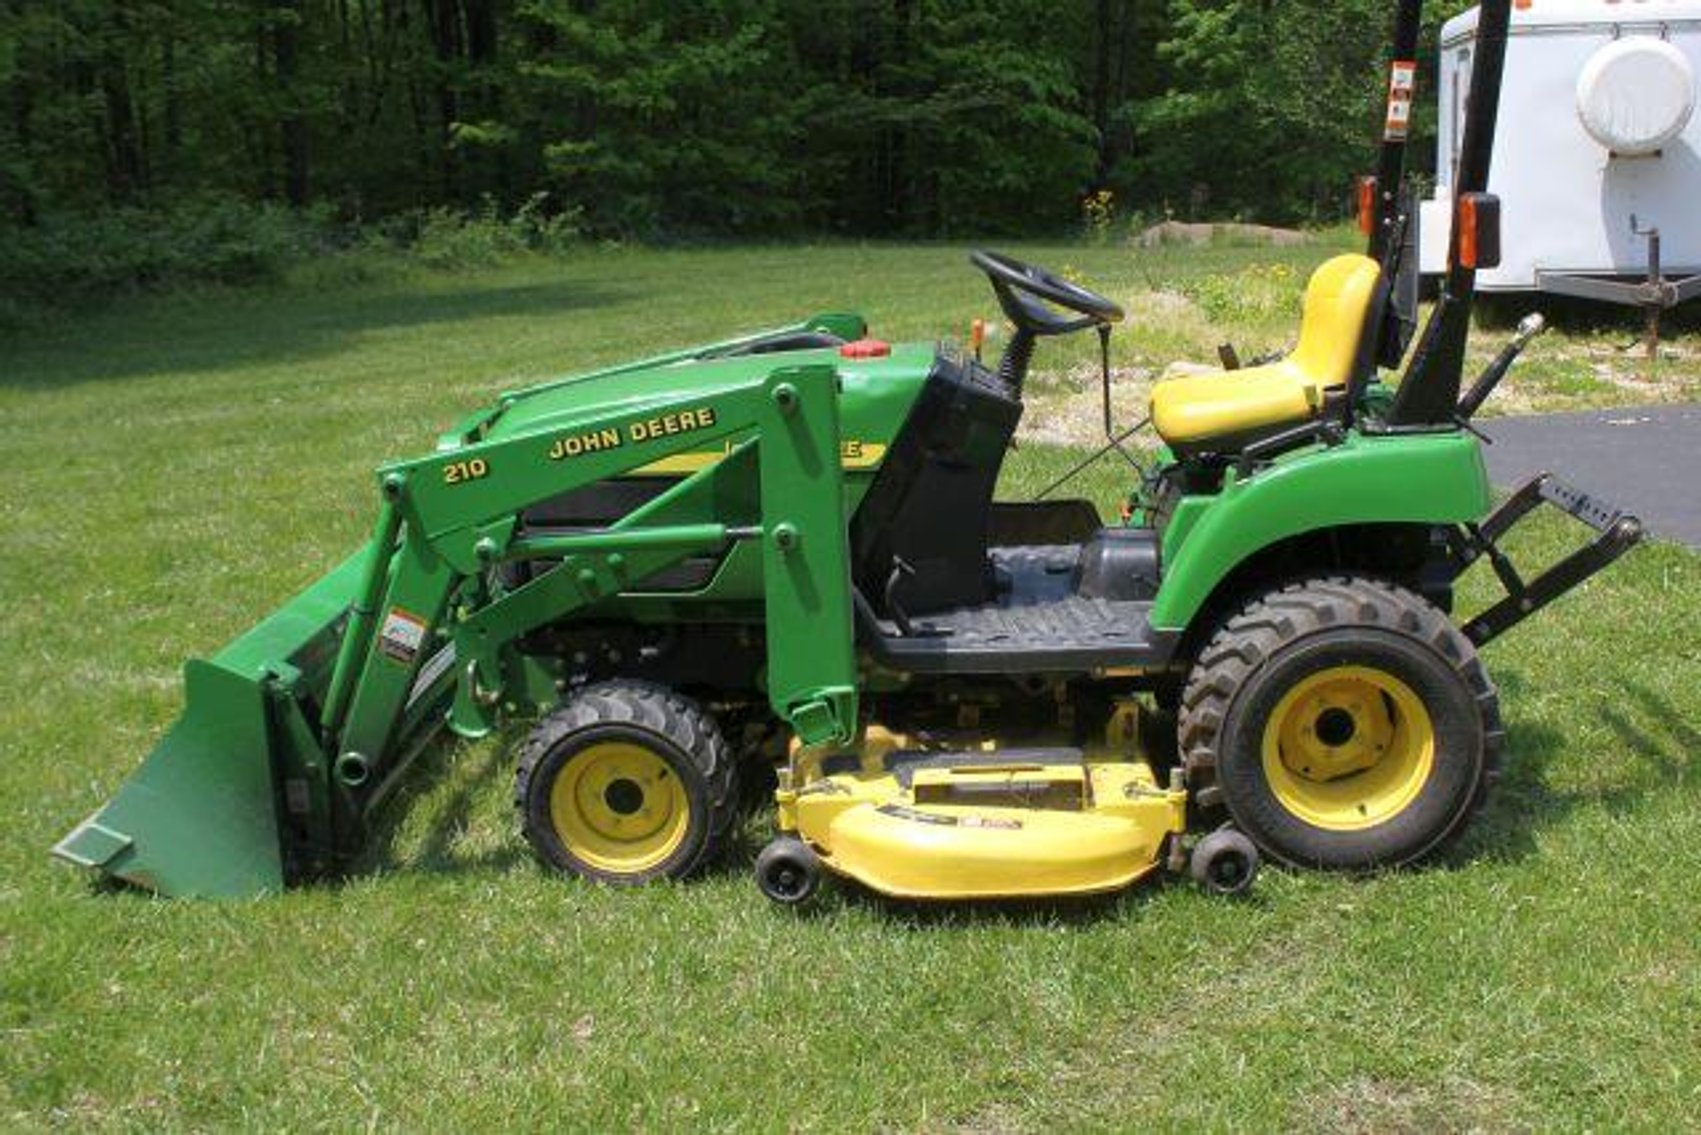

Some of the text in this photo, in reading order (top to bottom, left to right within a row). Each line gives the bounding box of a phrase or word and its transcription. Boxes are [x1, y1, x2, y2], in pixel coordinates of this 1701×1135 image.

[549, 408, 716, 460] JOHN DEERE
[442, 458, 488, 484] 210
